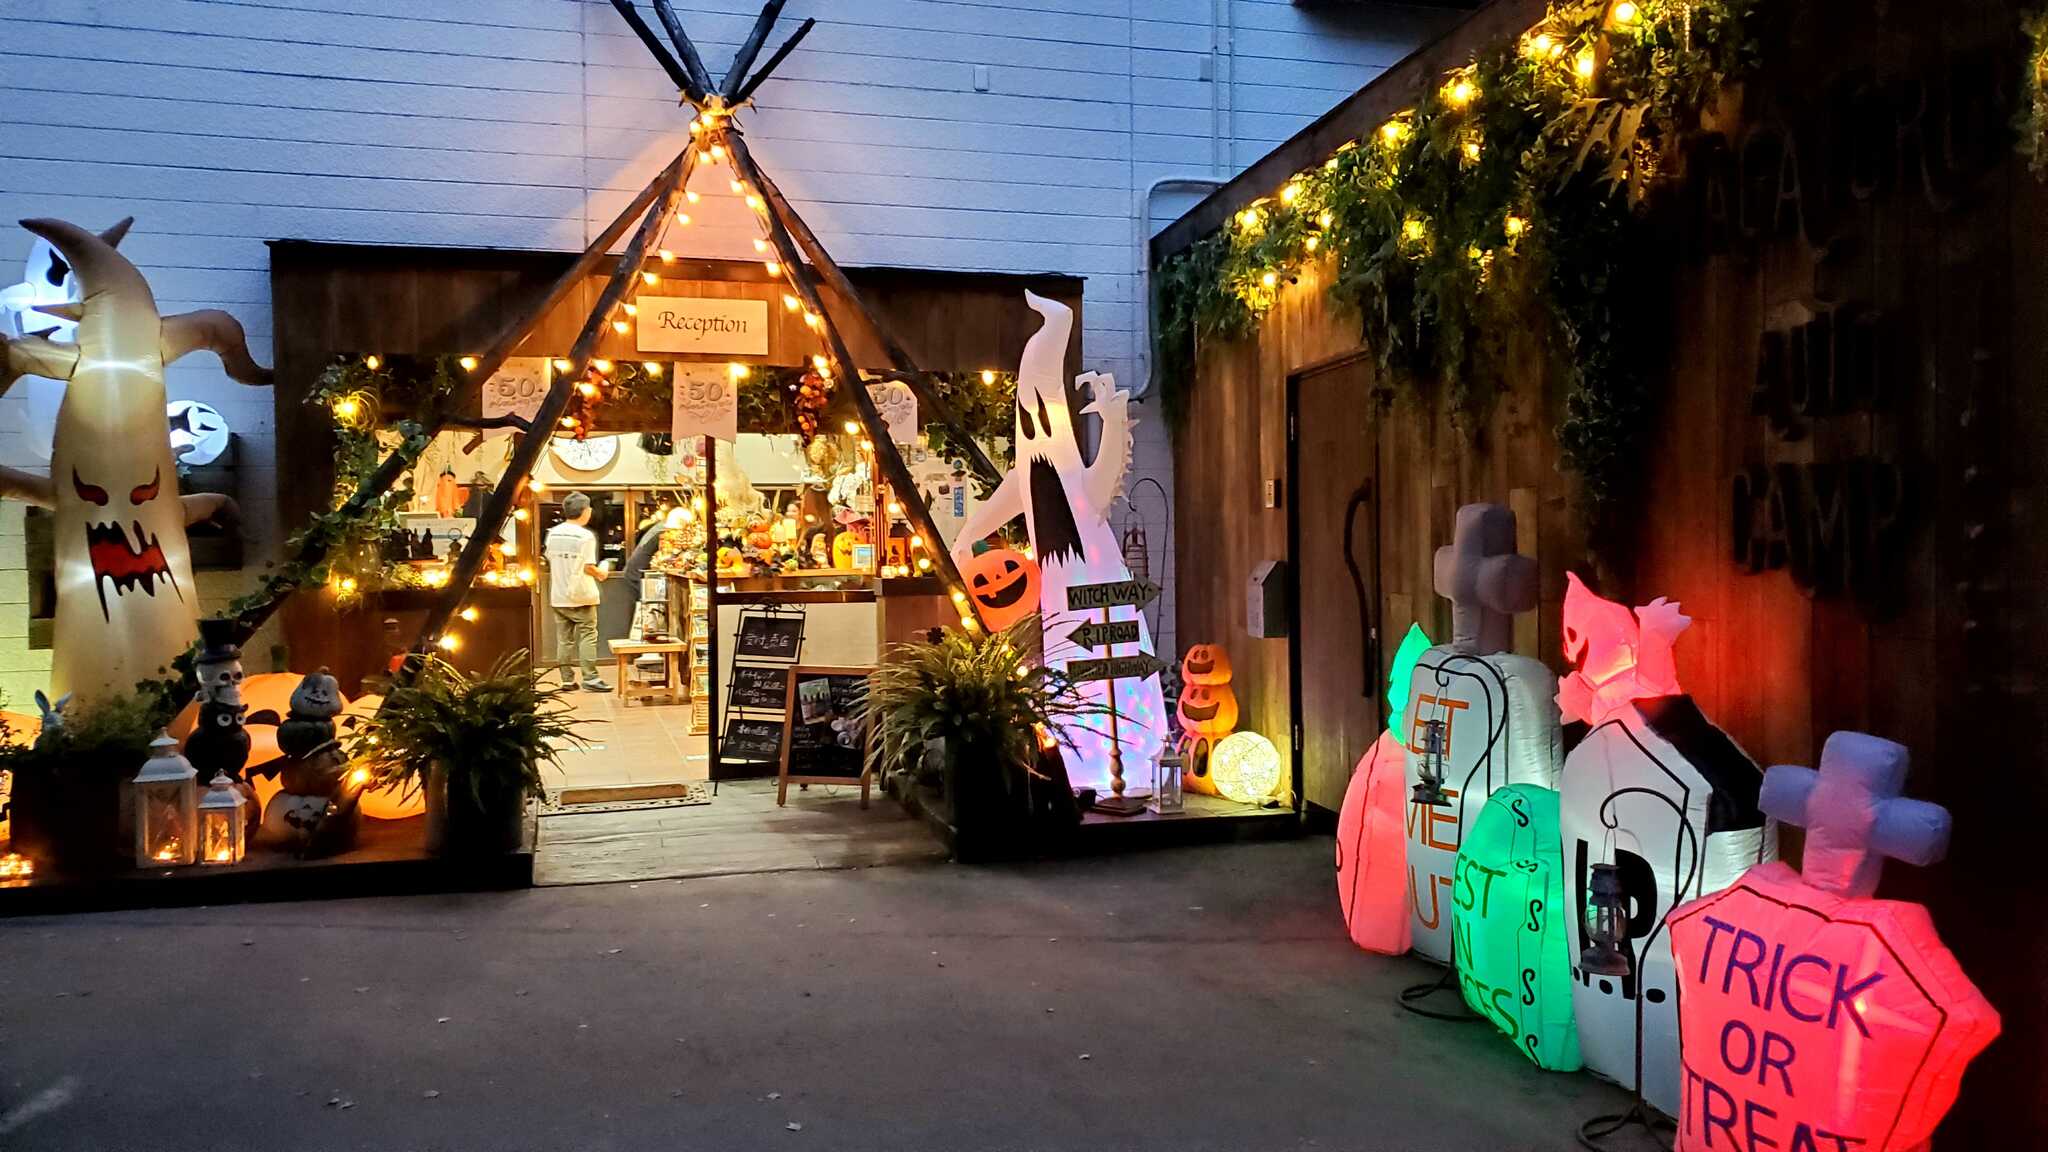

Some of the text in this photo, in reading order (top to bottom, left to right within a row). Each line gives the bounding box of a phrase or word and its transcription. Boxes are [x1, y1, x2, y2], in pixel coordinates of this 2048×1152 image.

[658, 310, 748, 341] Reception
[497, 377, 536, 398] 50
[687, 381, 723, 402] 50
[1070, 583, 1148, 606] WITCH WAY
[1406, 693, 1469, 761] ET
[1453, 852, 1508, 919] EST
[1699, 914, 1888, 1040] TRICK
[1719, 1018, 1797, 1098] OR
